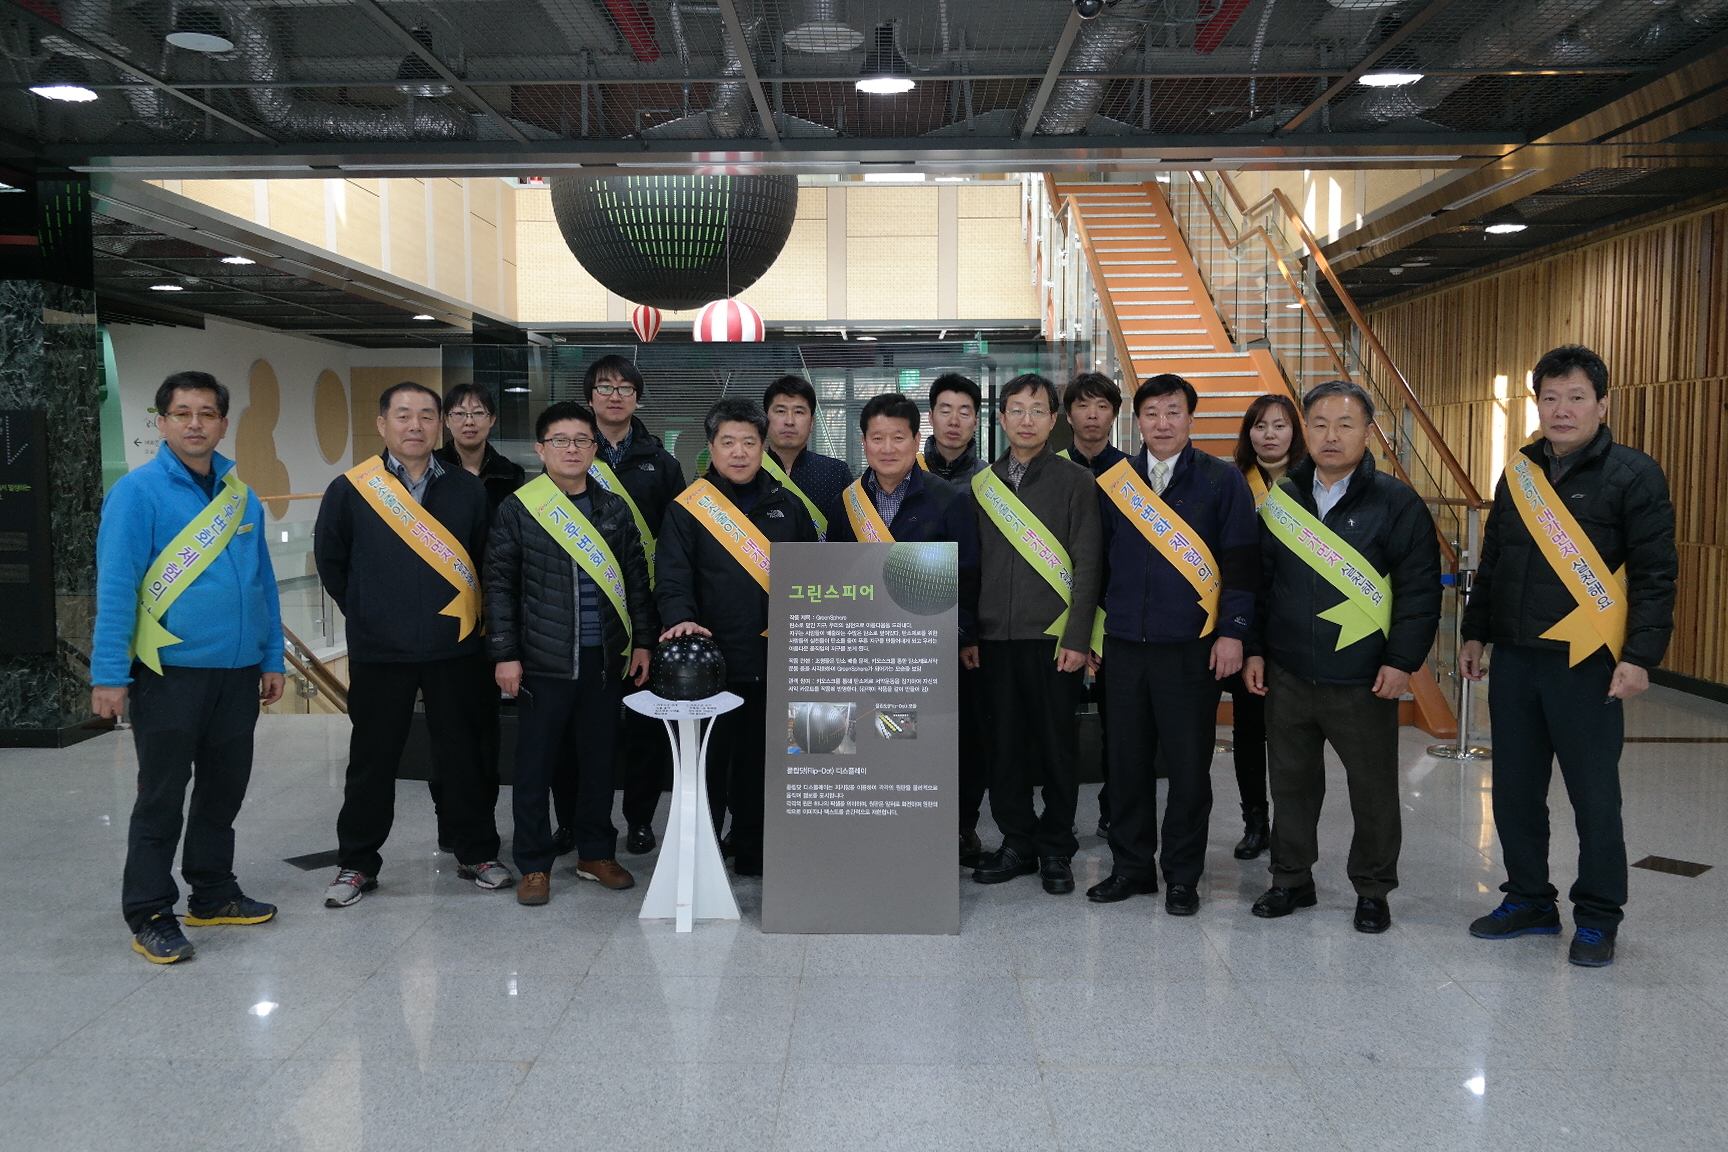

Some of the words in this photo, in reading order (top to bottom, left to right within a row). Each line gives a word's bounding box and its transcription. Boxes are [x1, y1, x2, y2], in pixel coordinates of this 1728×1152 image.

[367, 475, 417, 526] 탄소줄이기
[411, 521, 456, 564] 내가먼저
[549, 506, 608, 568] 기후변화
[696, 494, 748, 544] 탄소줄이기
[984, 486, 1027, 534] 탄소줄이기
[1021, 528, 1064, 570] 내가먼저
[1119, 480, 1174, 538] 기후변화
[1169, 532, 1215, 583] 체험의
[1513, 458, 1546, 512] 탄소줄이기
[1536, 507, 1580, 558] 내가먼저
[1571, 556, 1615, 613] 실천해요
[148, 546, 200, 602] 체험의
[788, 584, 874, 603] 그린스피어
[1297, 527, 1344, 568] 내가먼저
[1340, 562, 1385, 608] 실천해요
